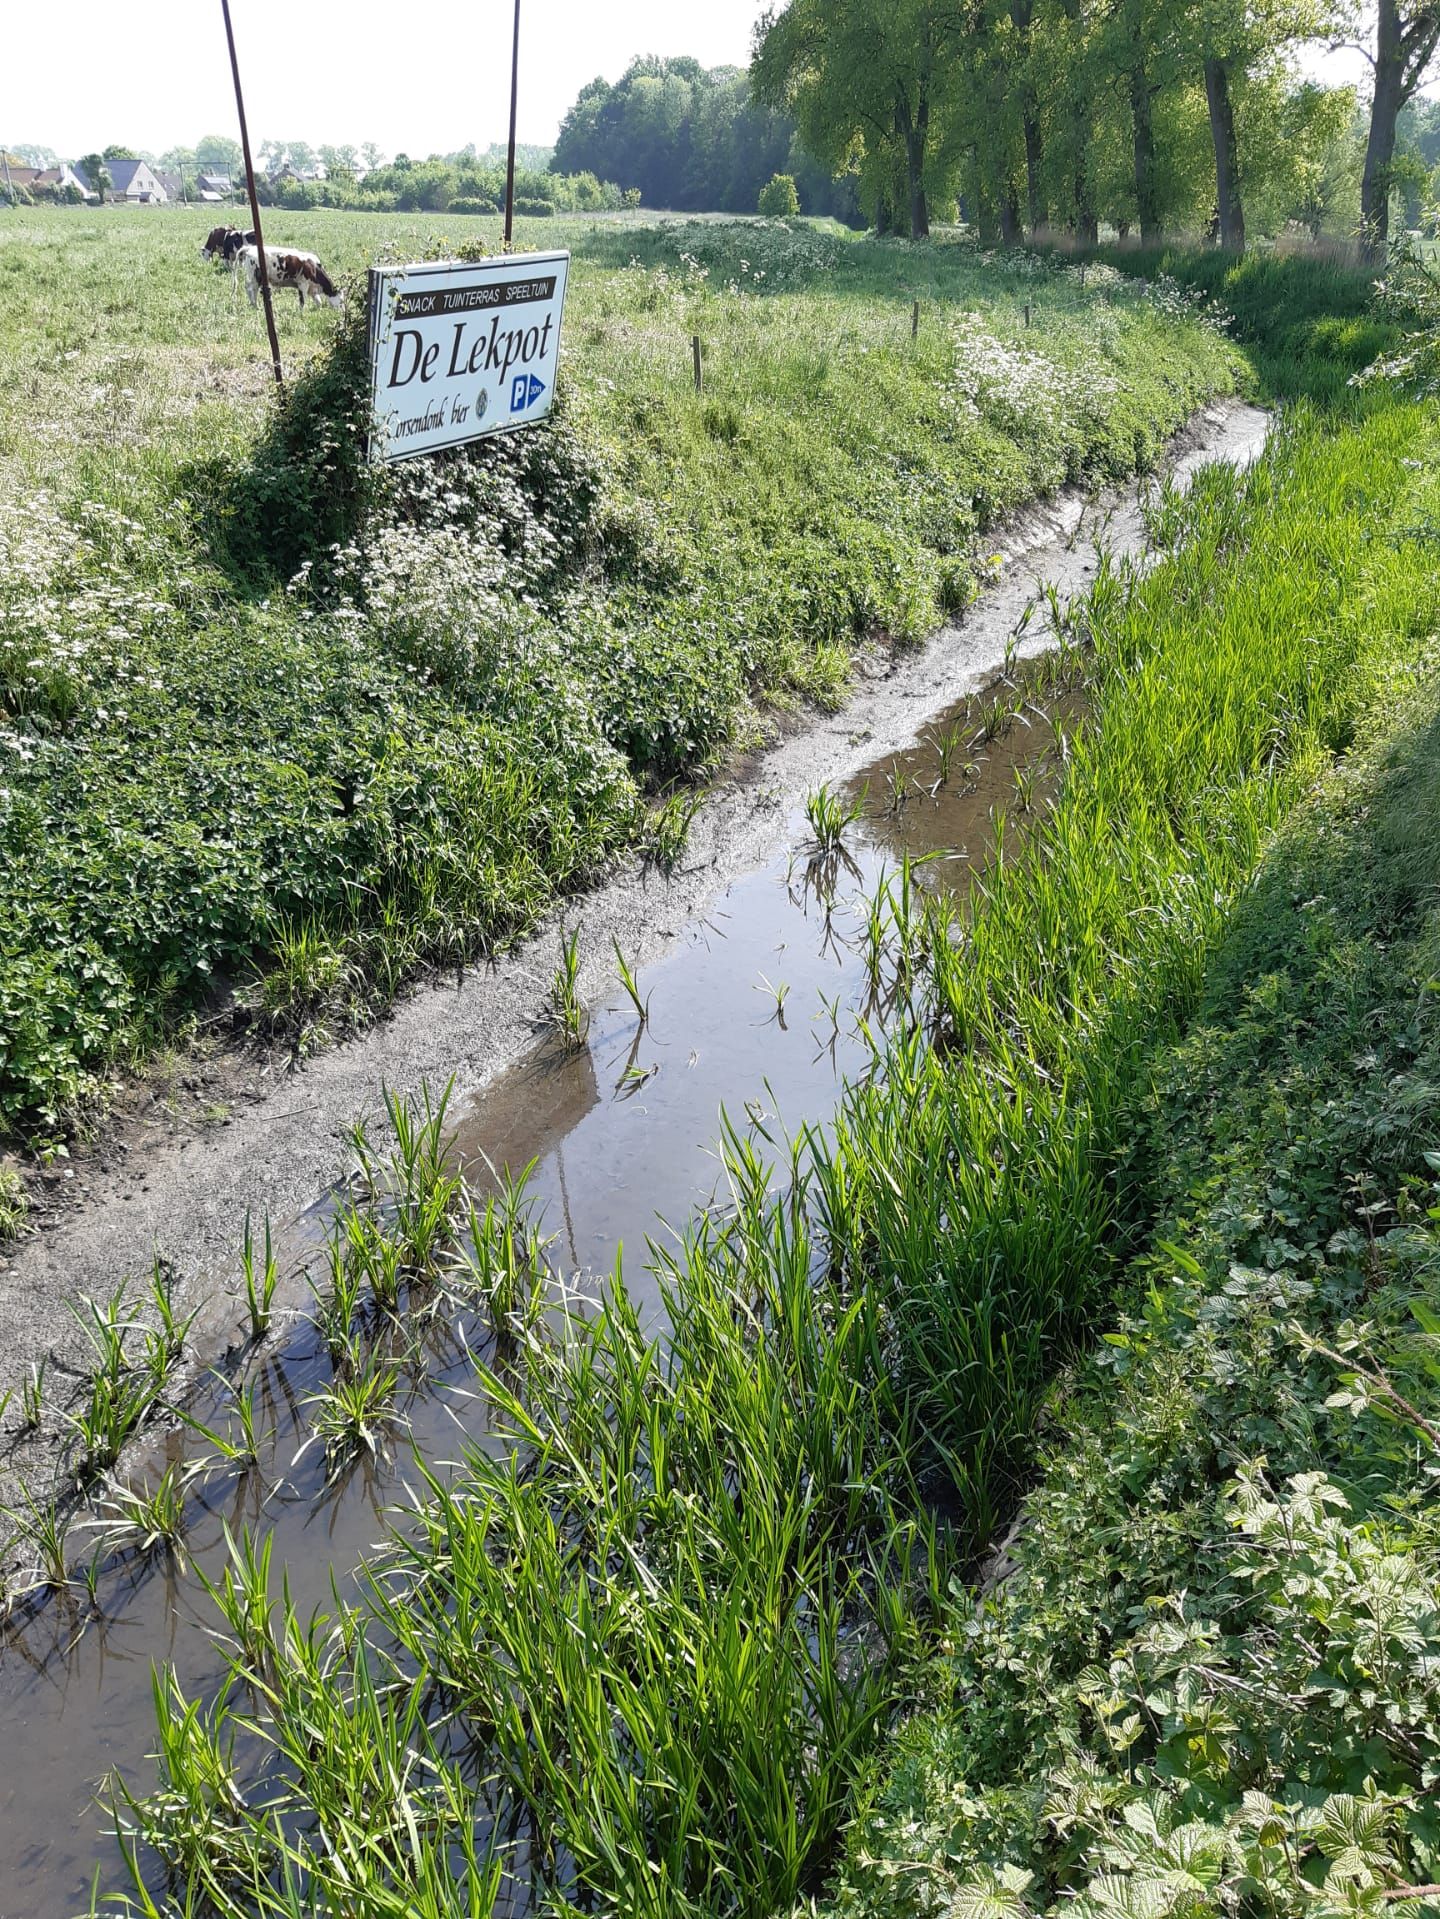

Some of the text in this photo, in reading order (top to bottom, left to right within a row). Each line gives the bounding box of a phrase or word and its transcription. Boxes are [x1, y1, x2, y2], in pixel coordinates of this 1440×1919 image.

[399, 282, 549, 314] SNACK TUINTERRAS SPEELTUIN
[386, 312, 553, 388] De Lekpot
[451, 393, 470, 425] bier
[513, 380, 525, 408] P
